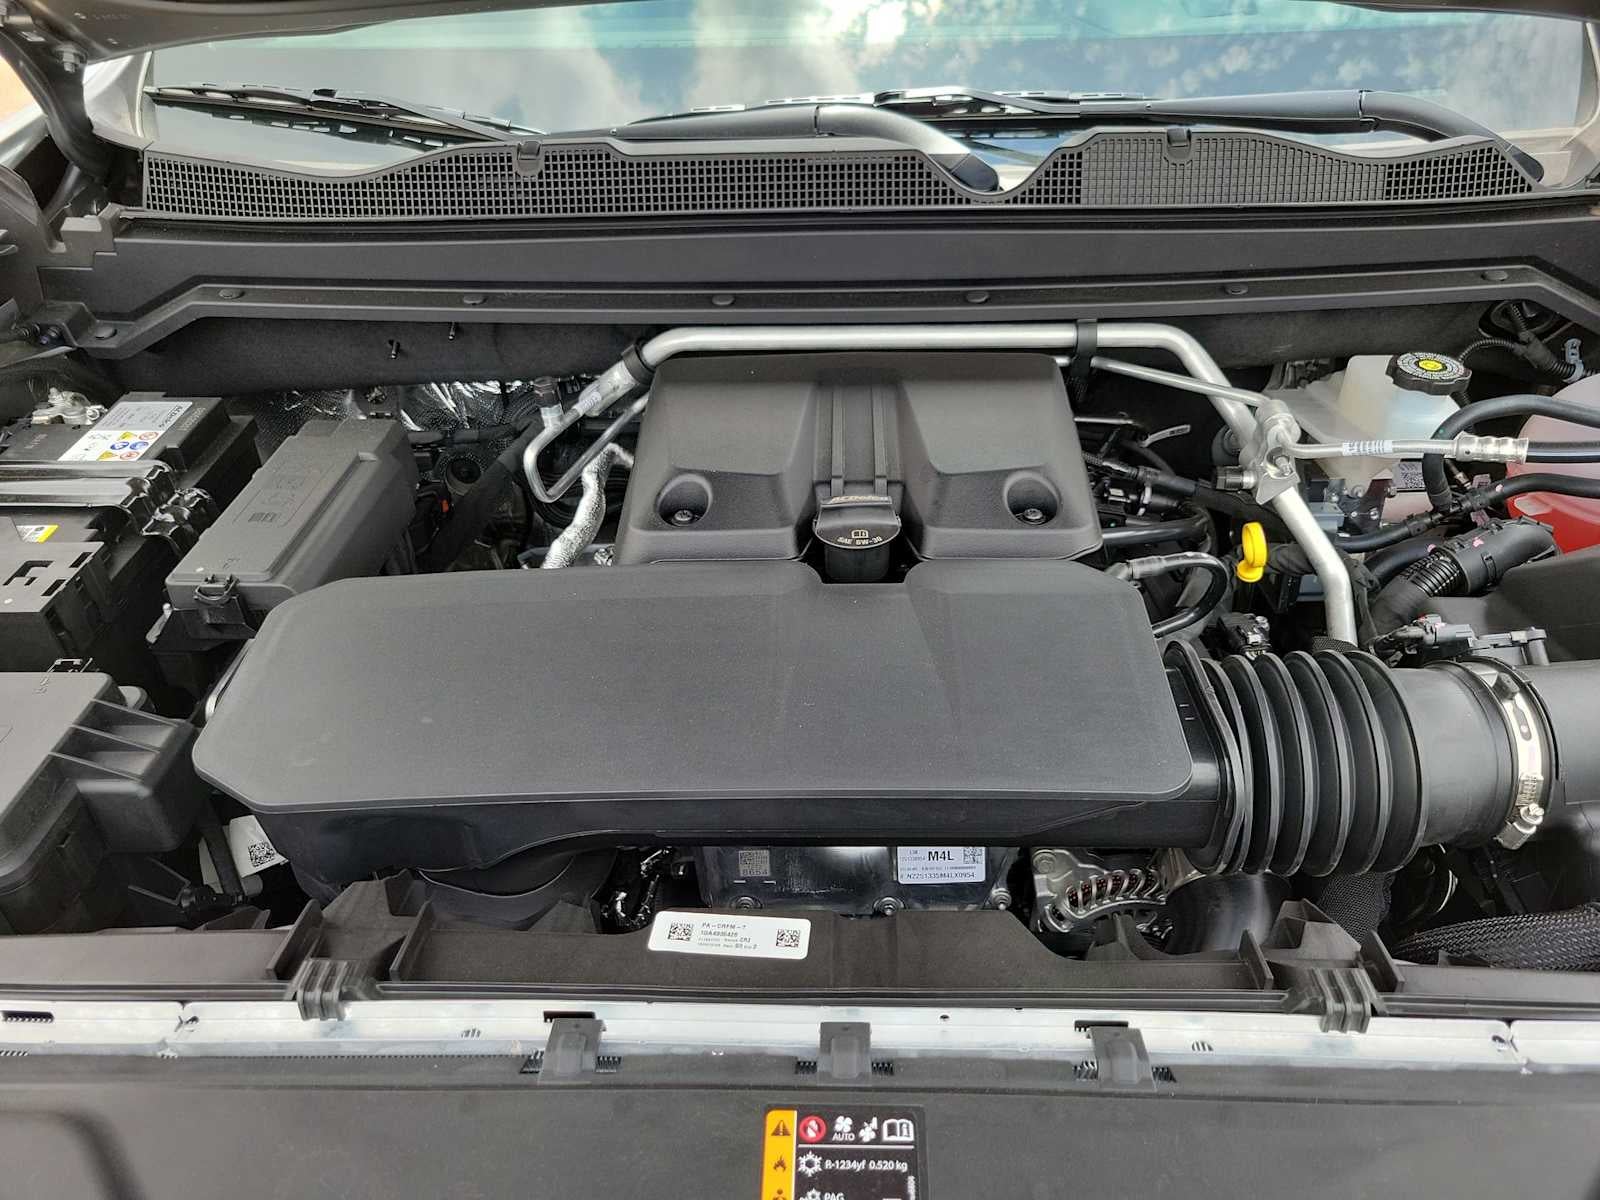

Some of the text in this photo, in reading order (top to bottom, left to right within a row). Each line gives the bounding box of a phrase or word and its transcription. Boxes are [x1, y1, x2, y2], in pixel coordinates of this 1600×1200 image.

[928, 850, 954, 861] M4L
[832, 1133, 855, 1142] AUTO
[824, 1160, 908, 1173] R-1234yf 0.520 kg
[824, 1192, 845, 1200] PAG
